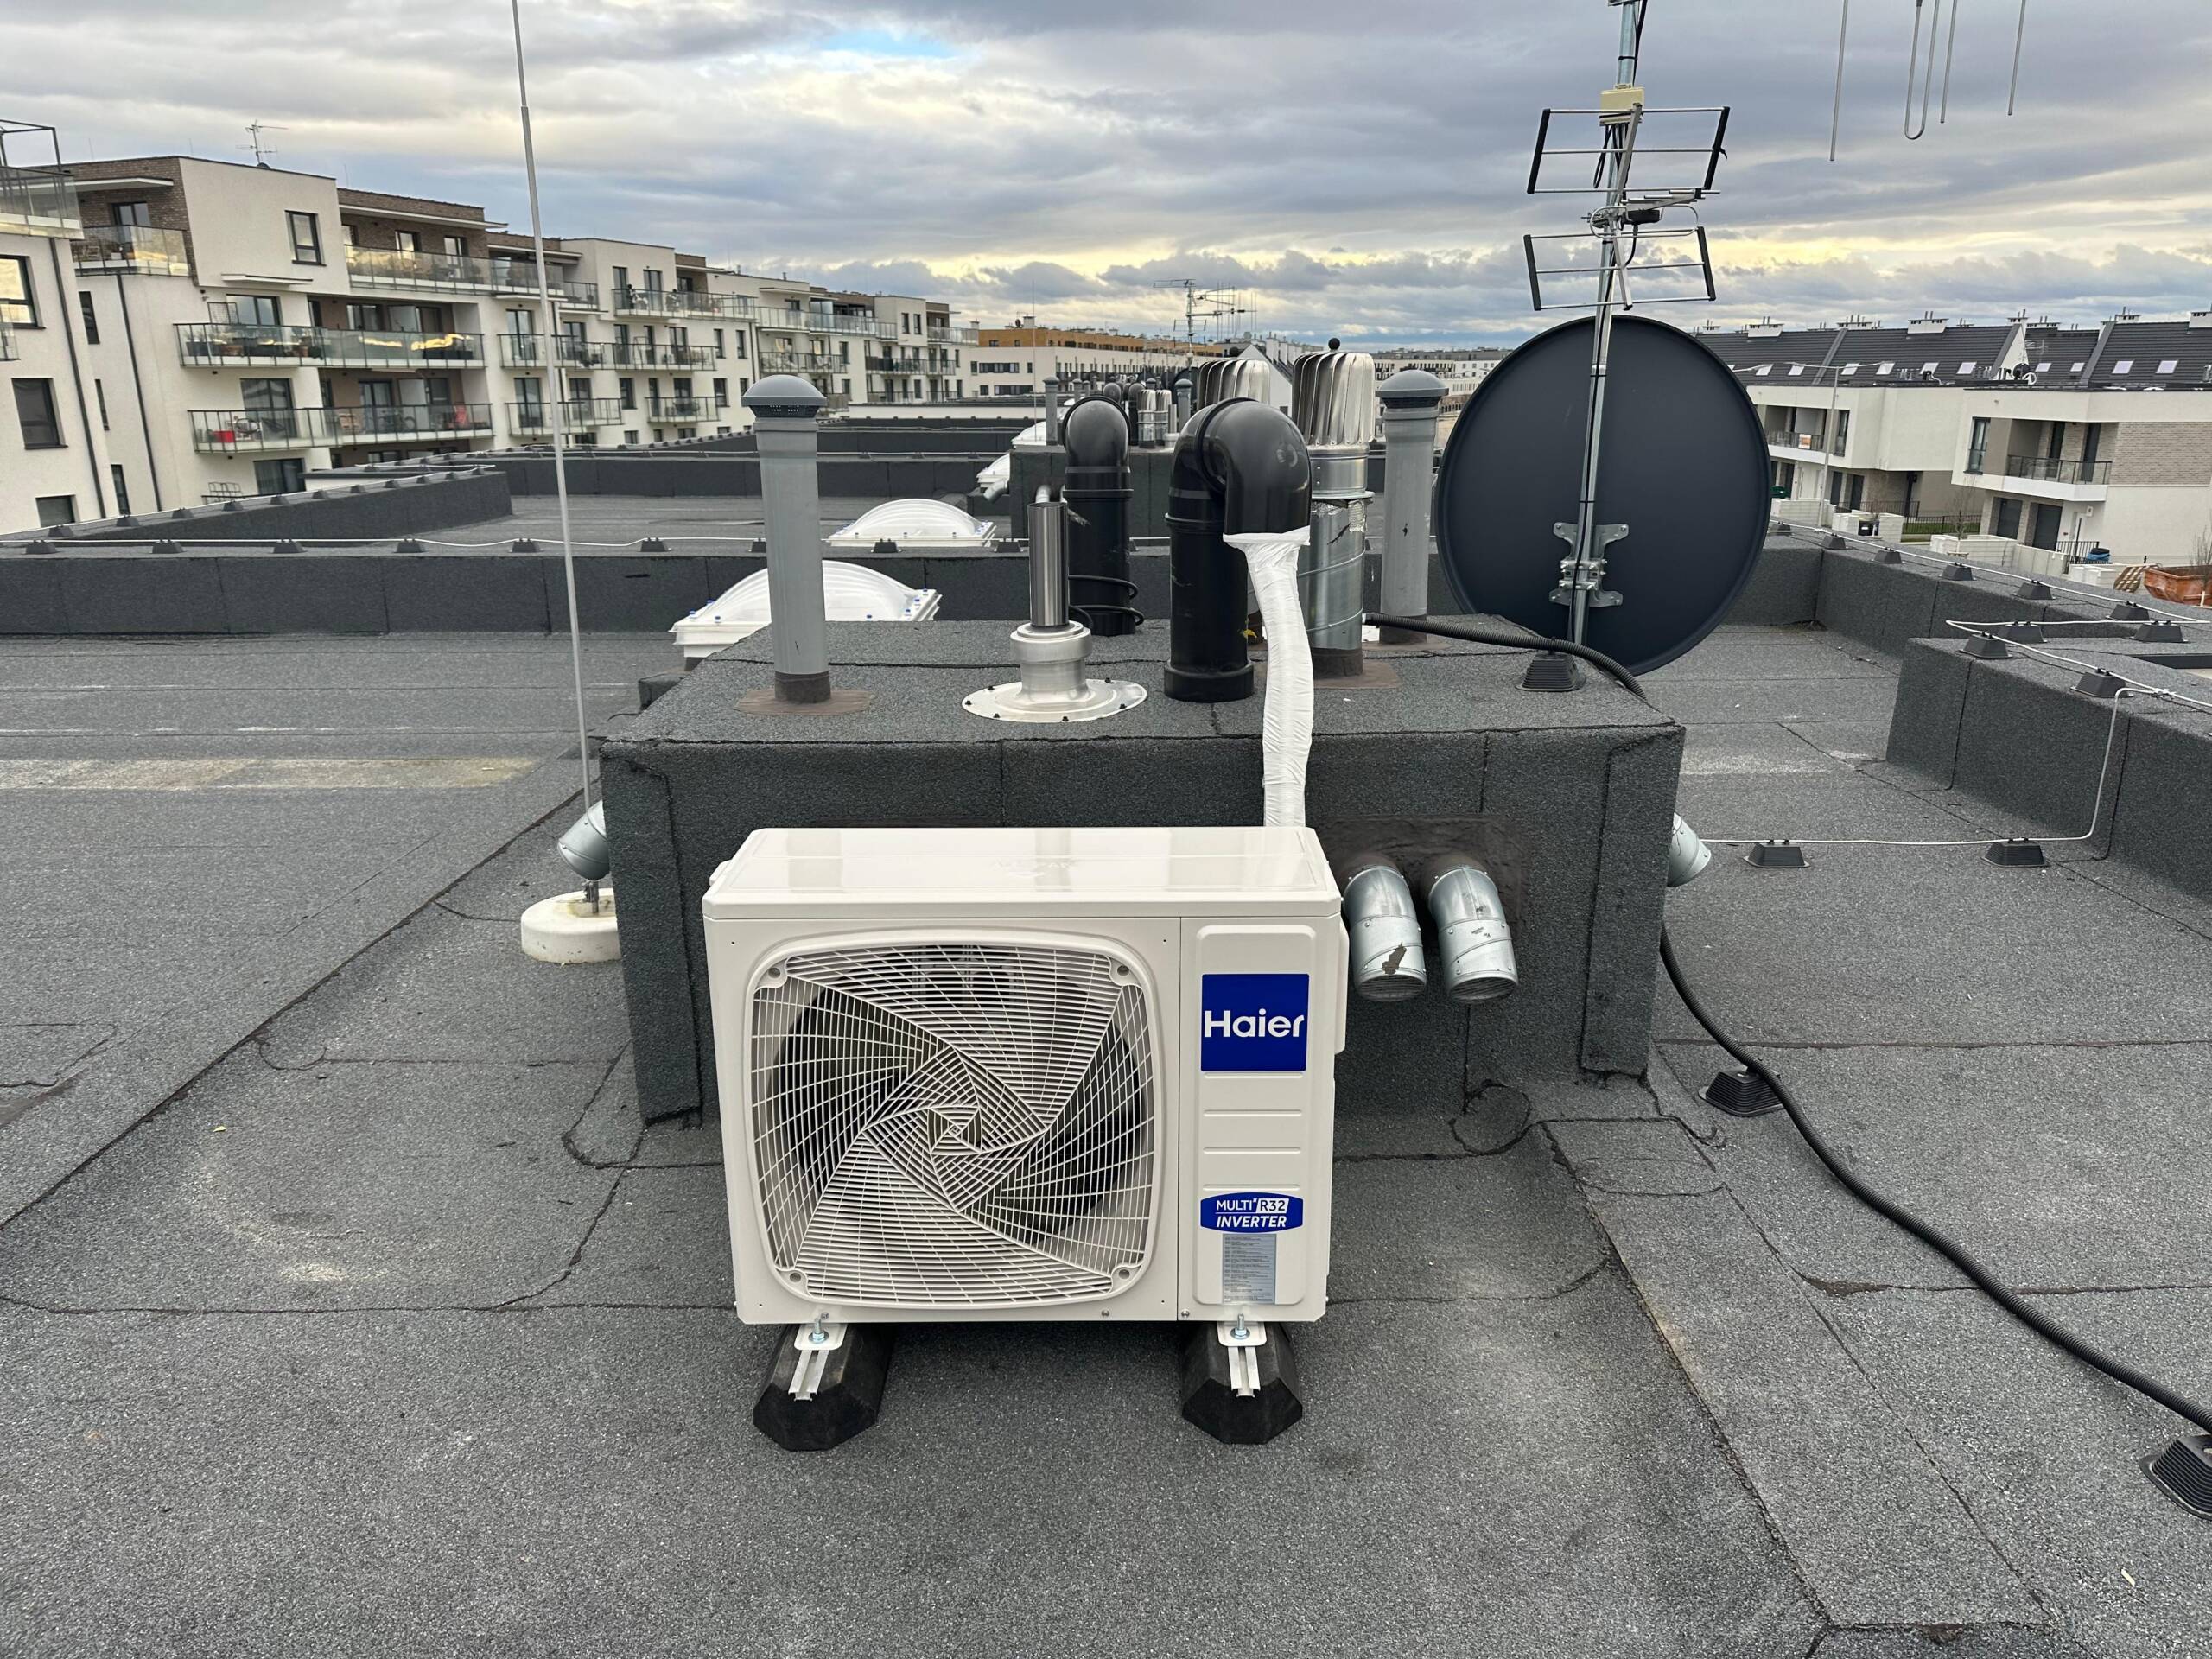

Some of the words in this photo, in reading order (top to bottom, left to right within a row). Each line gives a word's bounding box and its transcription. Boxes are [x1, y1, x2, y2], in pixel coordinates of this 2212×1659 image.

[1204, 1008, 1305, 1038] Haier
[1260, 1199, 1286, 1211] R32
[1216, 1215, 1287, 1228] INVERTER
